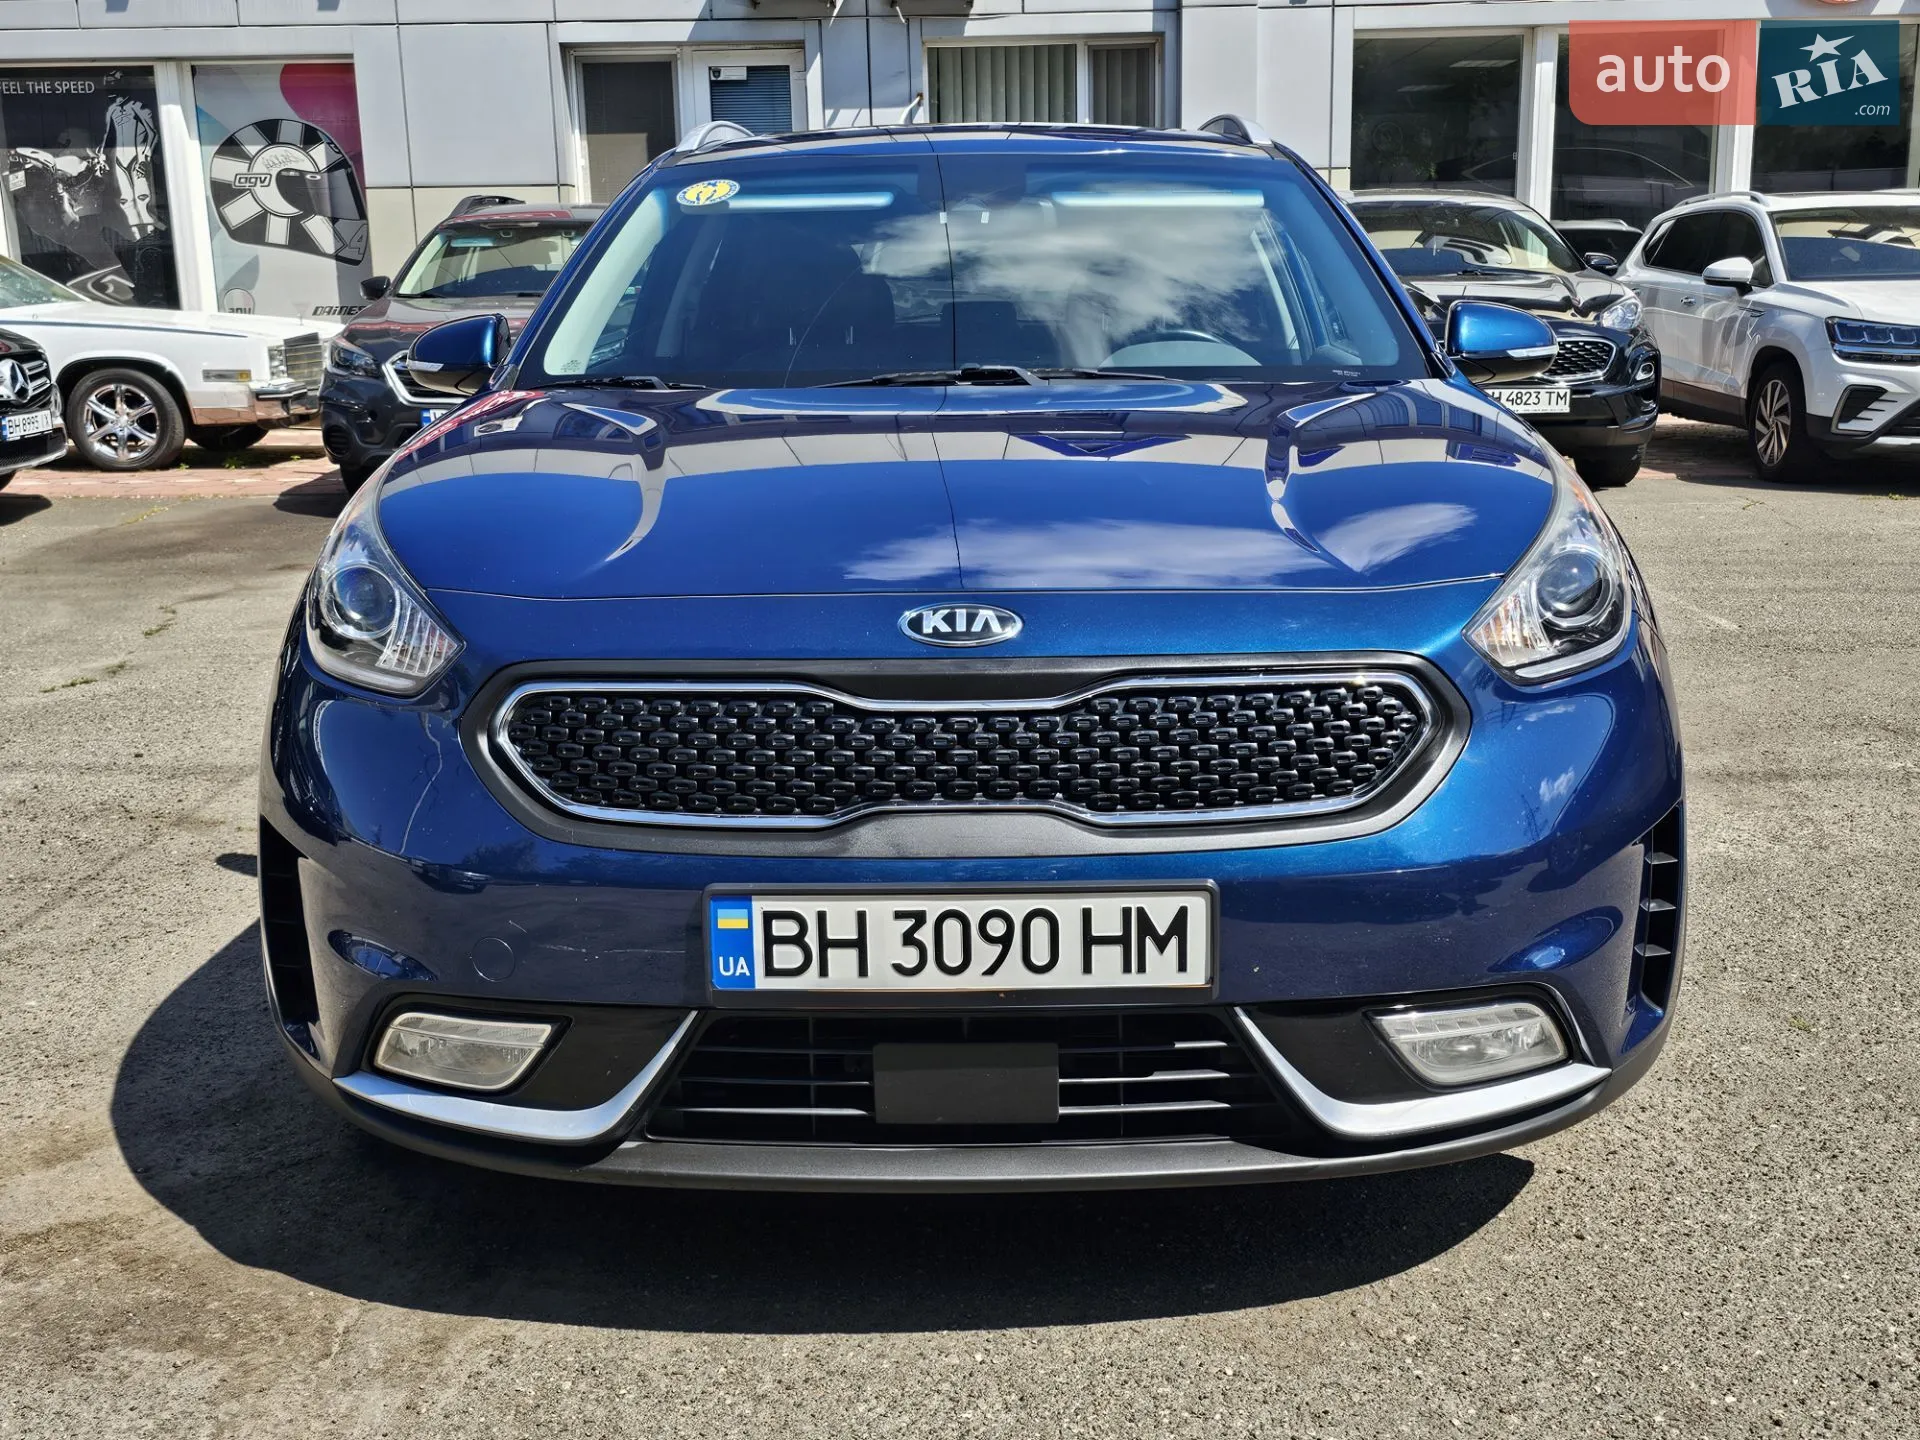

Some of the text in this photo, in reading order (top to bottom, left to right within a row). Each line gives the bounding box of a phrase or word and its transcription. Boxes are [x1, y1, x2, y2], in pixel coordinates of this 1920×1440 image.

[0, 81, 95, 94] EEL THE SPEED
[238, 175, 269, 187] agv
[1505, 391, 1541, 406] 4823
[1545, 391, 1568, 406] TM
[8, 418, 21, 434] BH
[922, 608, 1004, 634] KIA
[762, 905, 1189, 978] BH 3090 HM
[719, 957, 750, 977] UA
